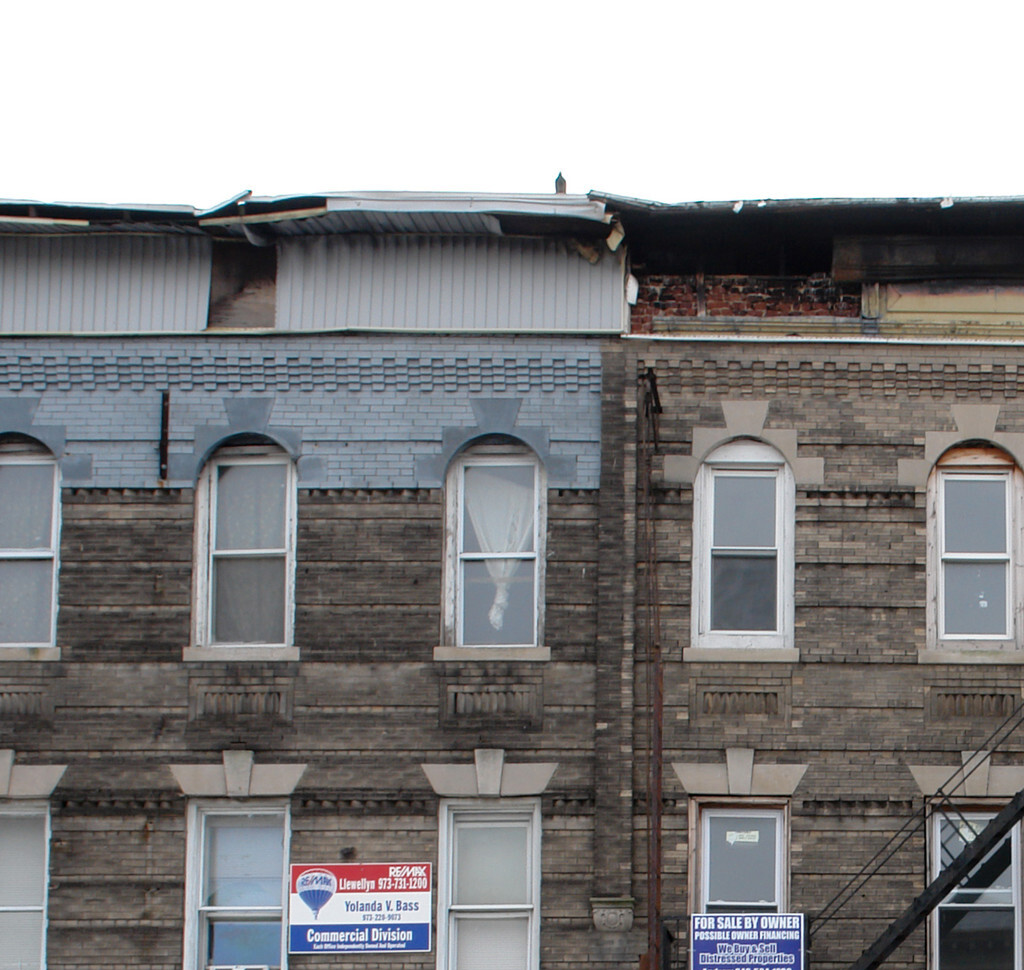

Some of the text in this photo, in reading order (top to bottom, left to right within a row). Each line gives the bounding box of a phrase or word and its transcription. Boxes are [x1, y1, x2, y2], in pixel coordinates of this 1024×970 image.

[388, 866, 426, 877] RE/MAX
[301, 876, 332, 887] RE/MAX
[339, 878, 427, 892] Llewellyn 973-731-1200
[345, 900, 419, 912] Yolanda V. Bass
[694, 916, 800, 929] FOR SALE BY OWNER
[306, 928, 412, 942] Commercial Division
[694, 930, 800, 940] POSSIBLE OWNER FINANCING
[717, 943, 777, 956] We Buy & Sell
[700, 953, 794, 965] Distressed Properties
